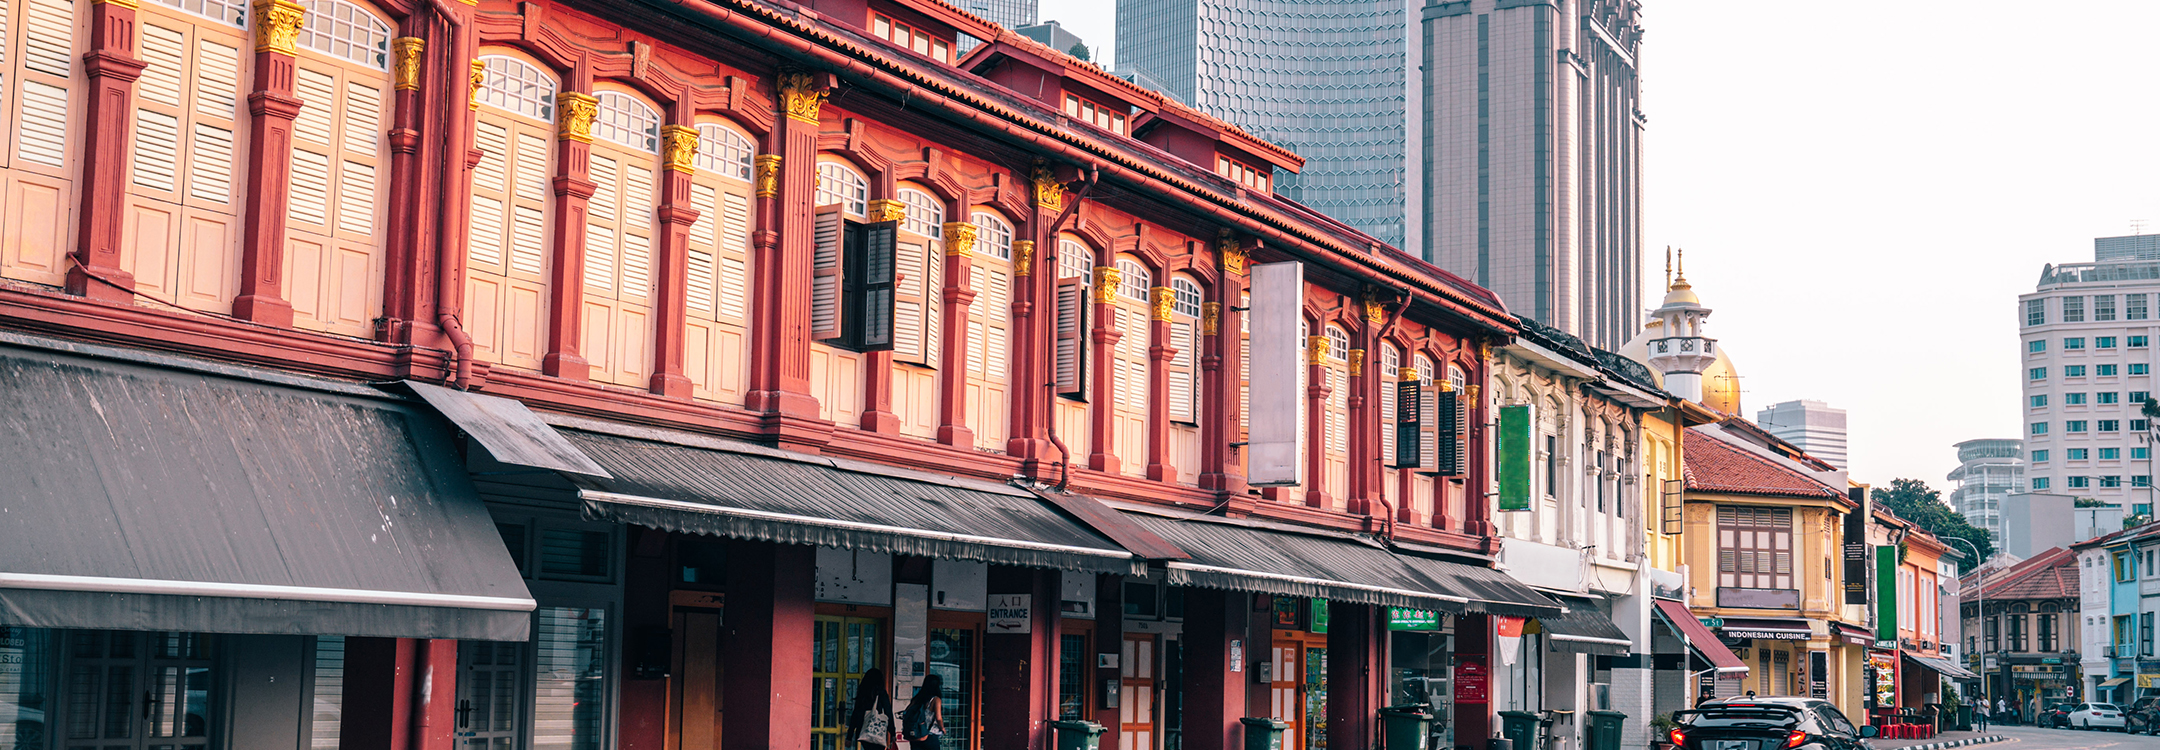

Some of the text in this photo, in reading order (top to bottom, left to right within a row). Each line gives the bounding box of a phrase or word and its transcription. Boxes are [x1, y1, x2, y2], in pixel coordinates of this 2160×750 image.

[999, 596, 1021, 607] 入口
[991, 609, 1028, 618] ENTRANCE
[1728, 631, 1806, 640] INDONESIAN CUISINE
[0, 638, 24, 646] LOSED
